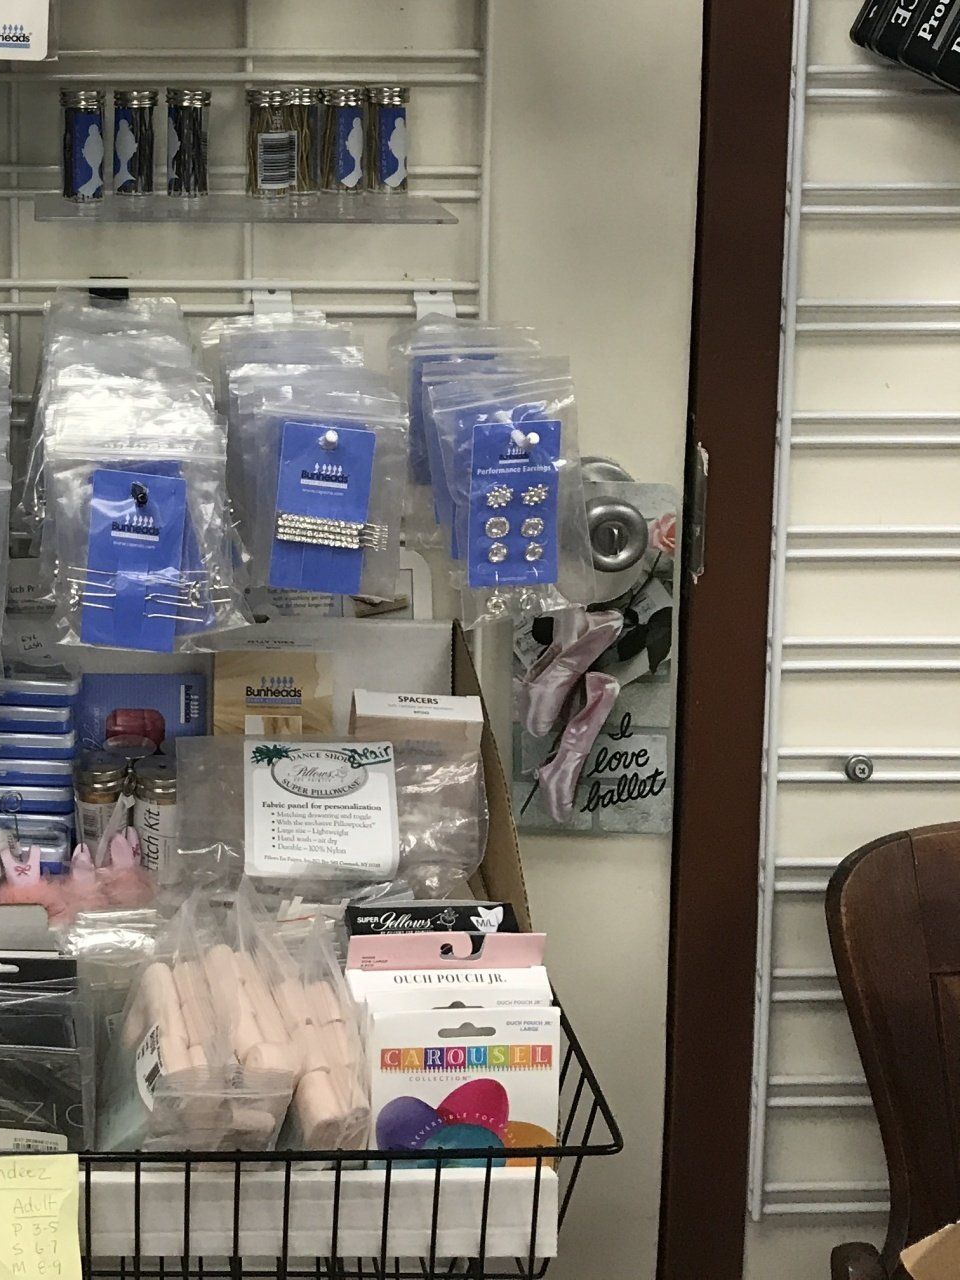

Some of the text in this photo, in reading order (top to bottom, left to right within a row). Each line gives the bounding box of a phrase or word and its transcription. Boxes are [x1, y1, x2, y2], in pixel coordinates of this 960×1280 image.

[301, 471, 349, 483] Bunheads
[477, 466, 521, 476] Performance
[111, 521, 160, 536] Bunheads
[246, 686, 302, 698] Bunheads
[398, 696, 439, 705] SPACERS
[608, 712, 634, 741] I
[587, 747, 650, 778] love
[281, 778, 361, 796] SUPER PILLOWCASE
[580, 768, 667, 813] ballet
[287, 802, 309, 810] panel
[324, 803, 382, 811] personalization
[144, 808, 160, 832] Kit
[476, 919, 496, 928] M/L
[394, 973, 507, 984] OUCH POUCH JR.
[383, 1045, 548, 1066] CAROUSEL
[13, 1194, 57, 1214] Adult
[12, 1223, 23, 1236] P
[12, 1243, 23, 1256] S
[13, 1261, 26, 1274] M
